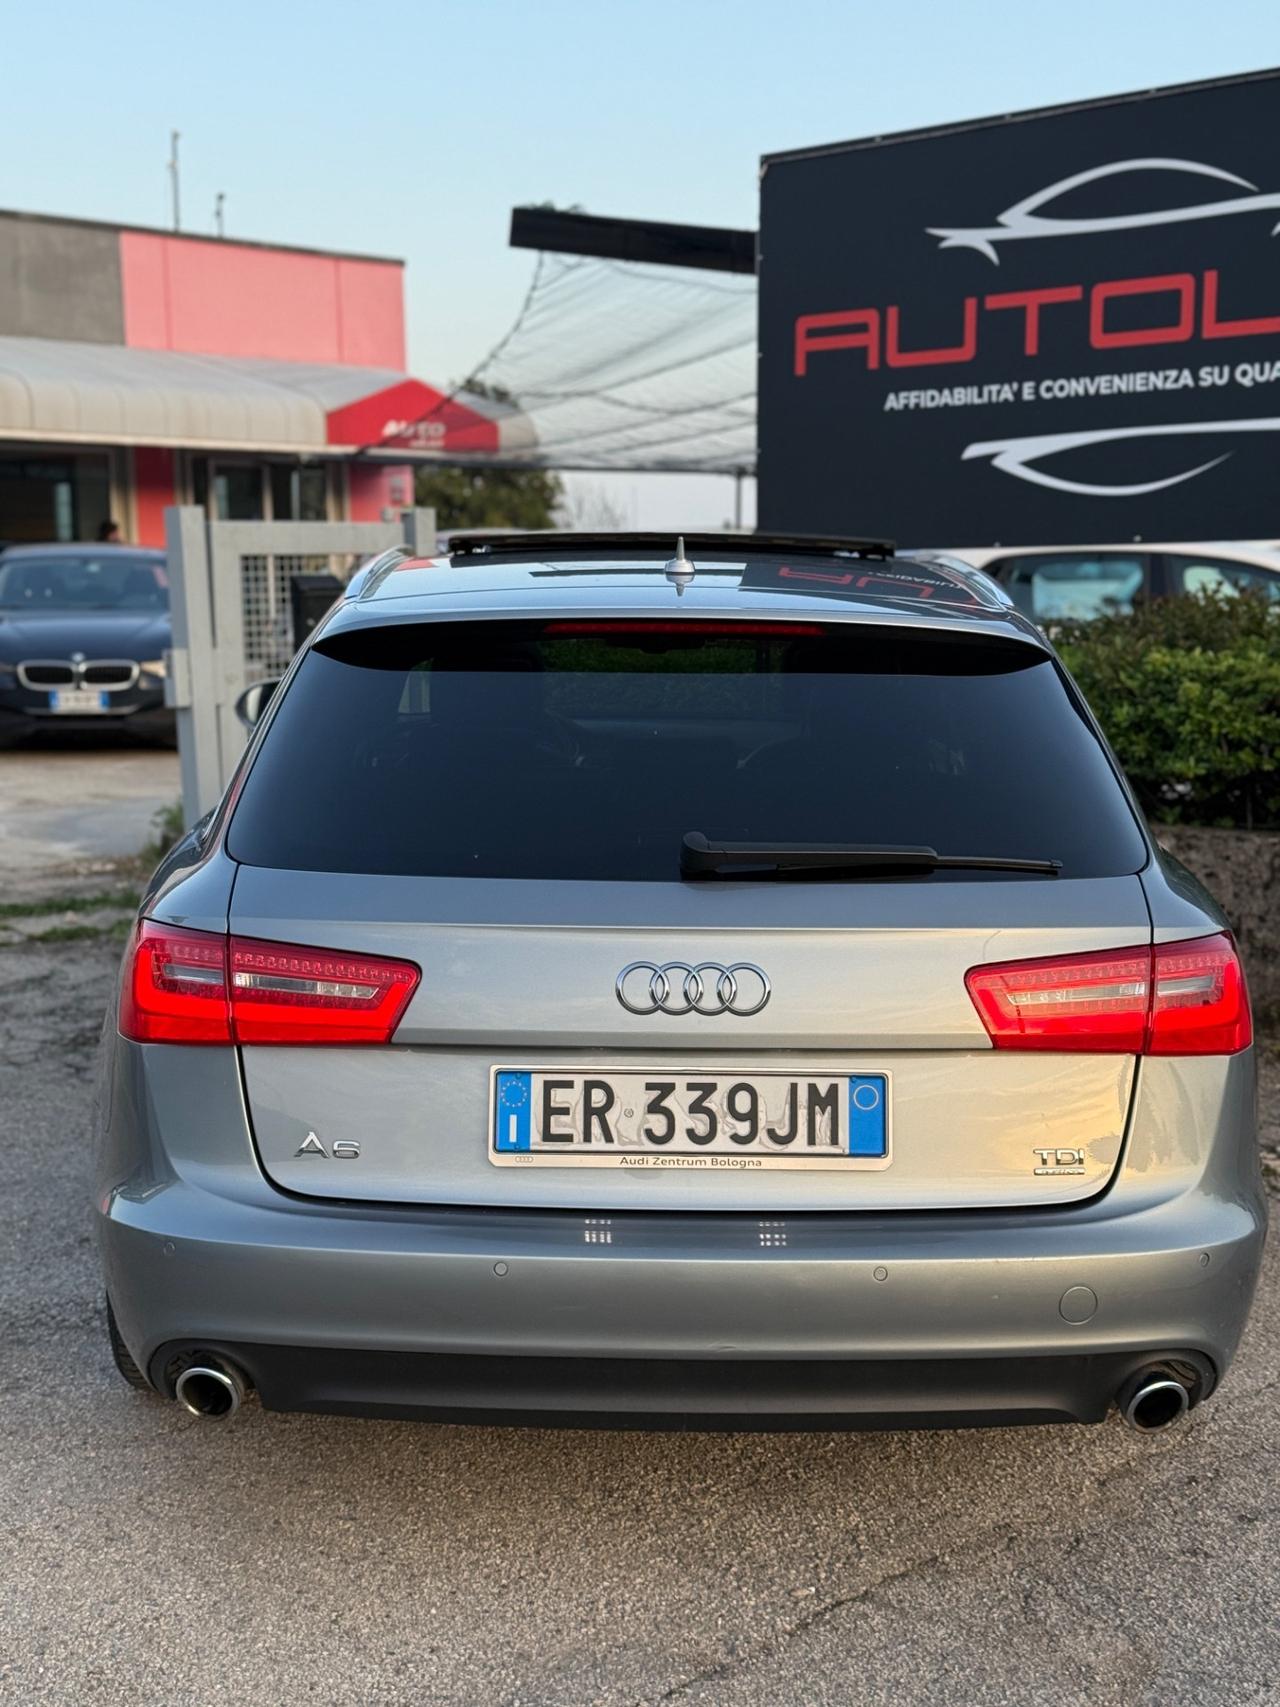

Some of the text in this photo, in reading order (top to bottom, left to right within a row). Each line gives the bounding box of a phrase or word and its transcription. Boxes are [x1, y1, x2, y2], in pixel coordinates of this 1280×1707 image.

[1022, 381, 1036, 401] E
[1039, 368, 1194, 399] CONVENIENZA
[1198, 364, 1230, 387] SU
[542, 1079, 615, 1144] ER
[294, 1131, 360, 1159] A6
[1033, 1148, 1085, 1166] TDI
[619, 1156, 762, 1169] Audi Zentrum Bologna
